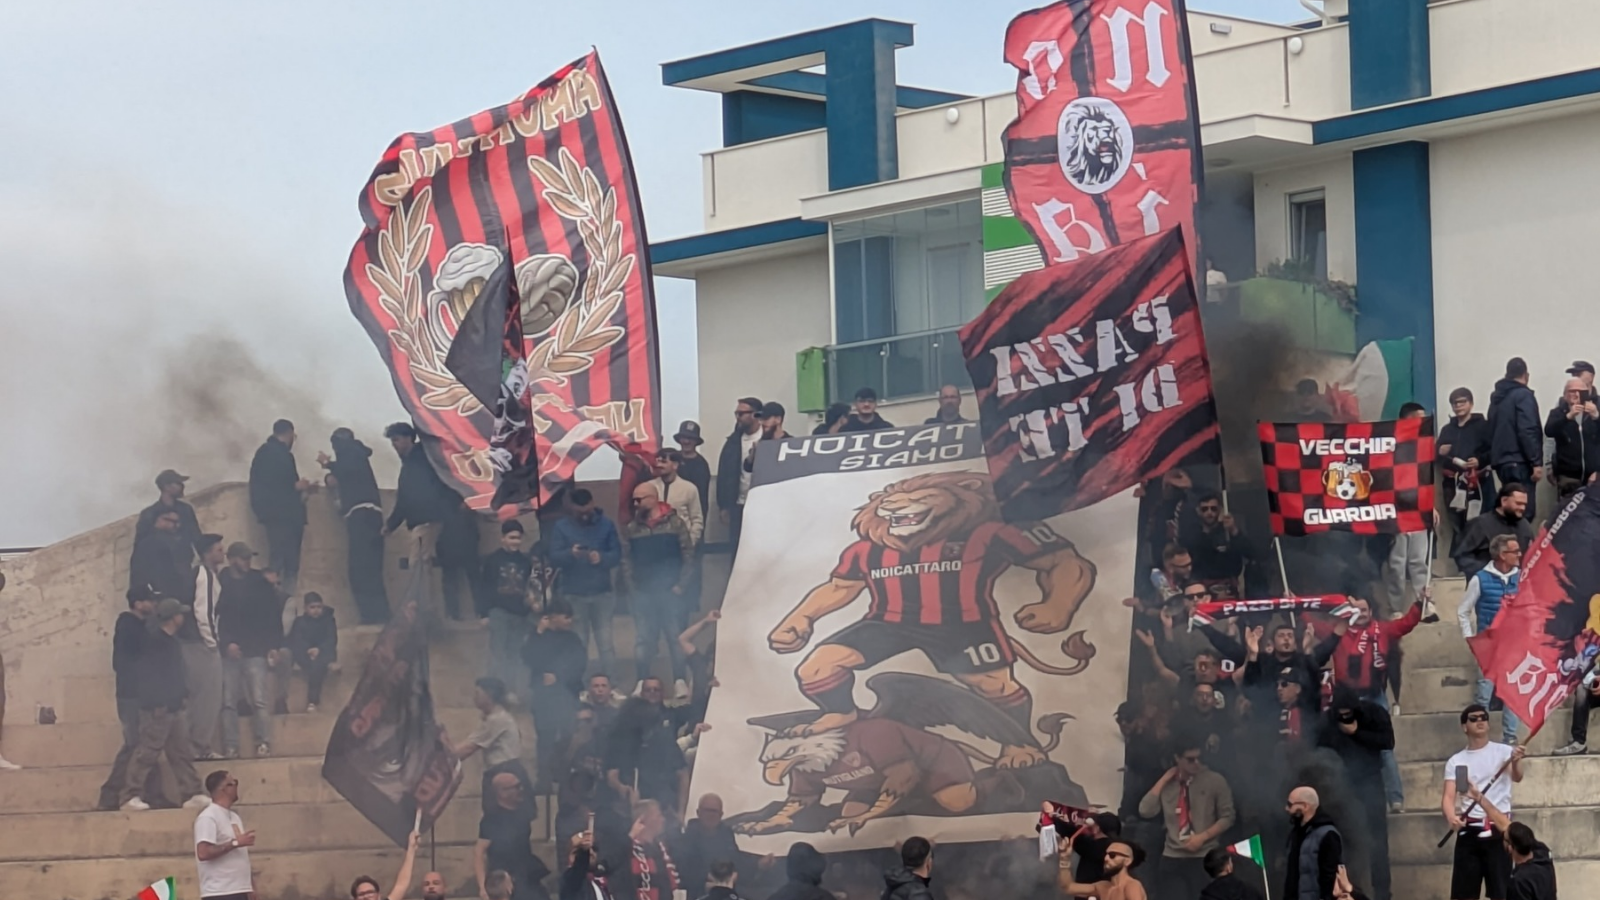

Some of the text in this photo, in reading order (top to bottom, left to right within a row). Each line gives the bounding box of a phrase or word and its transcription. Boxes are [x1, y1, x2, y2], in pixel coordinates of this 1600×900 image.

[778, 422, 977, 462] NOICAT
[1299, 437, 1396, 456] VECCHIA
[839, 443, 963, 471] SIAMO
[1303, 503, 1397, 526] GUARDIA
[870, 560, 962, 579] NOICATTARO
[964, 642, 1000, 667] 10
